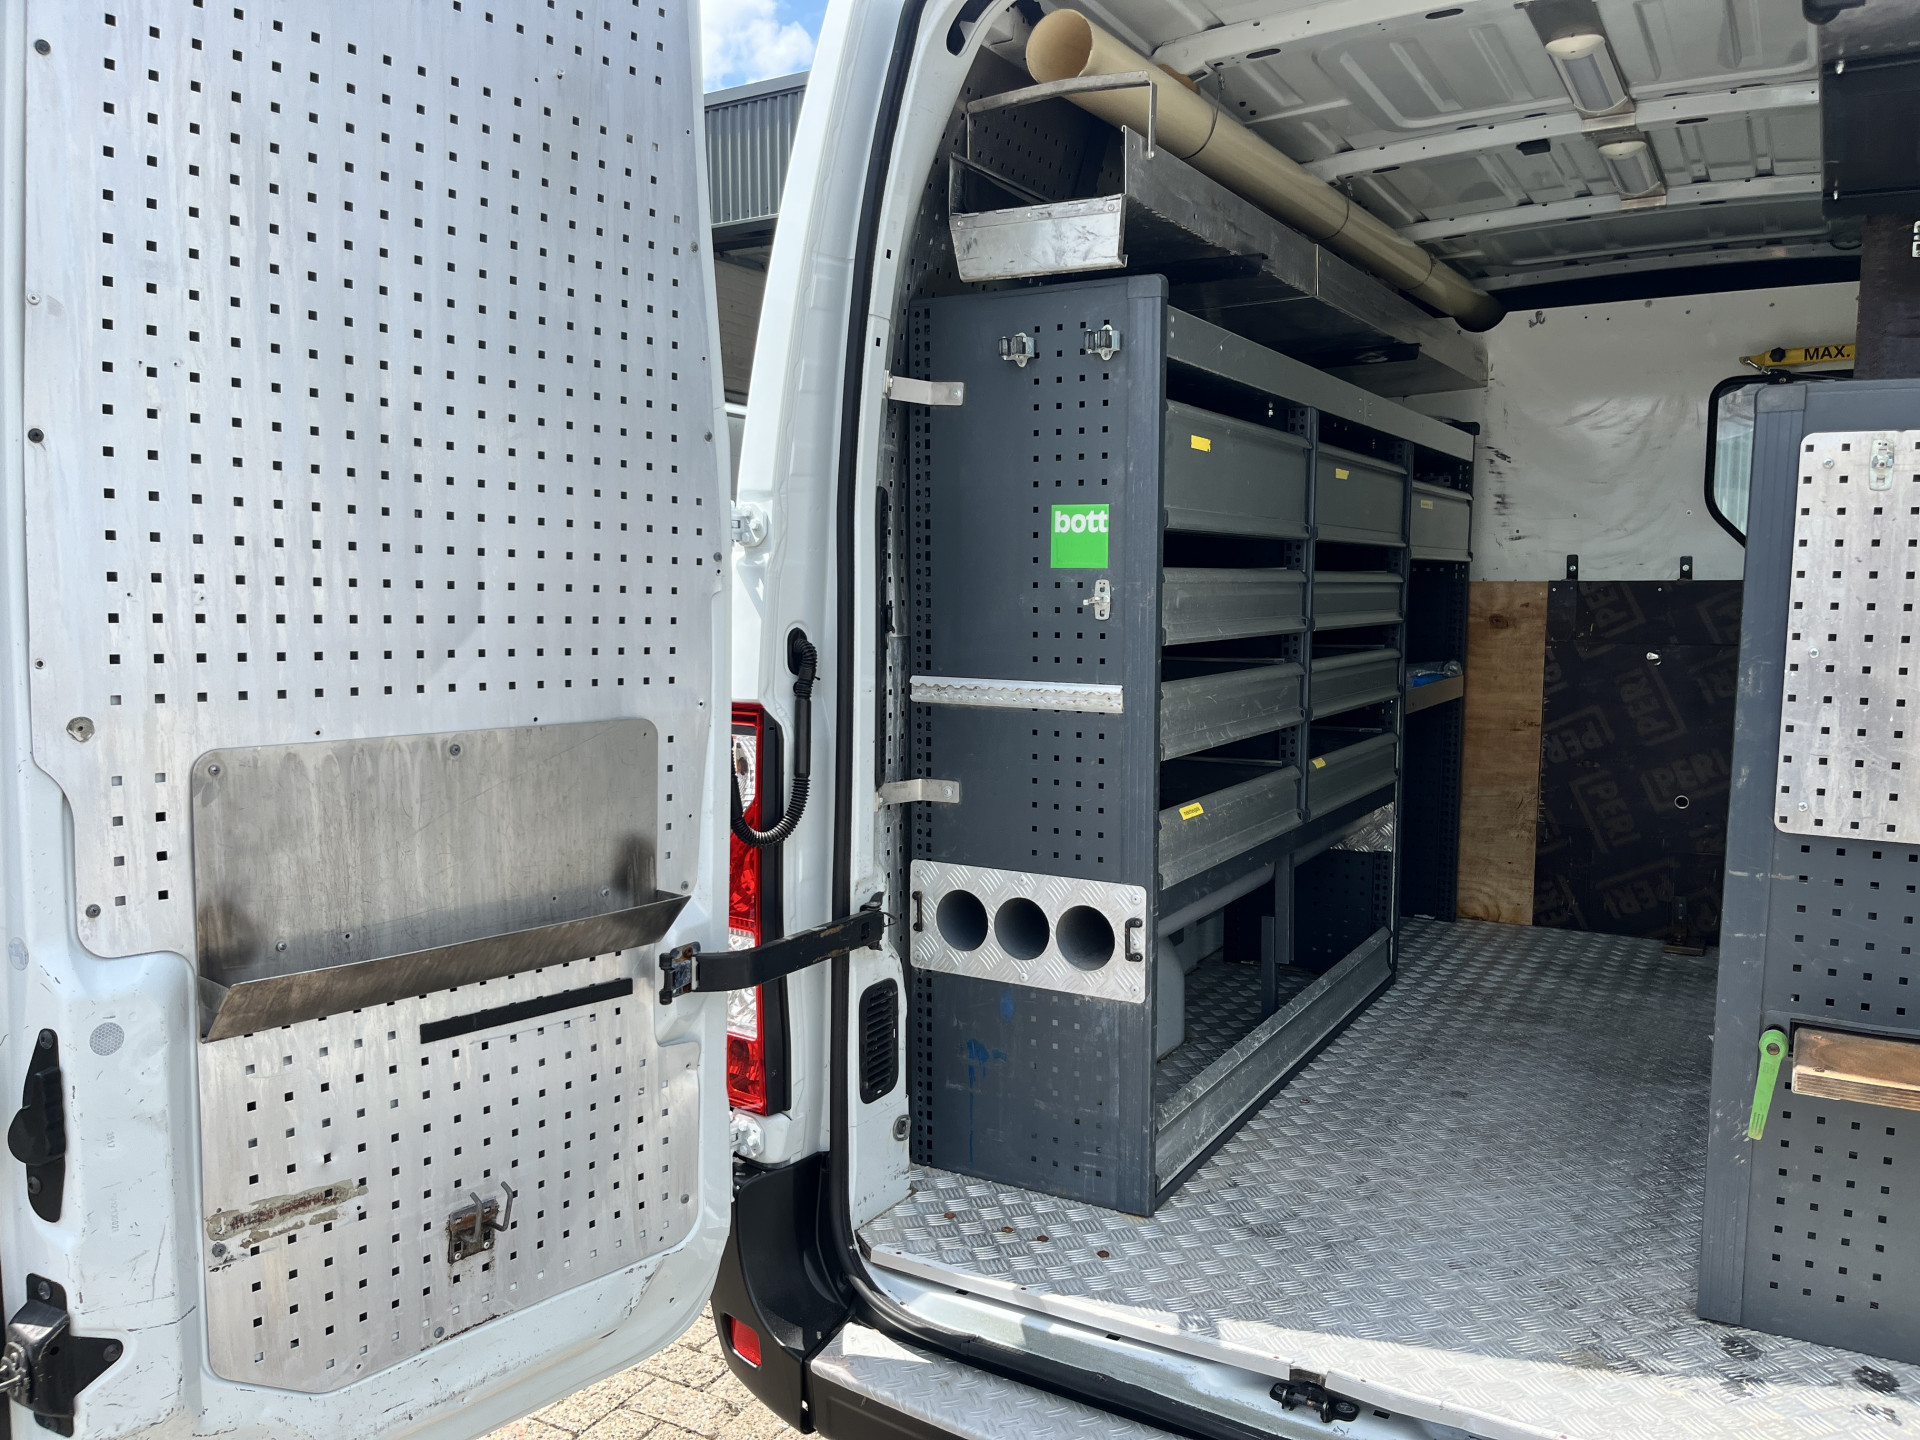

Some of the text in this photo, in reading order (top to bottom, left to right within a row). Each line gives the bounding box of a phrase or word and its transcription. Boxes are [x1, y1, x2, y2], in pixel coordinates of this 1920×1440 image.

[1804, 345, 1851, 361] MAX.
[1054, 510, 1109, 534] bott
[1651, 747, 1730, 798] PERI
[1586, 780, 1642, 849] PERI
